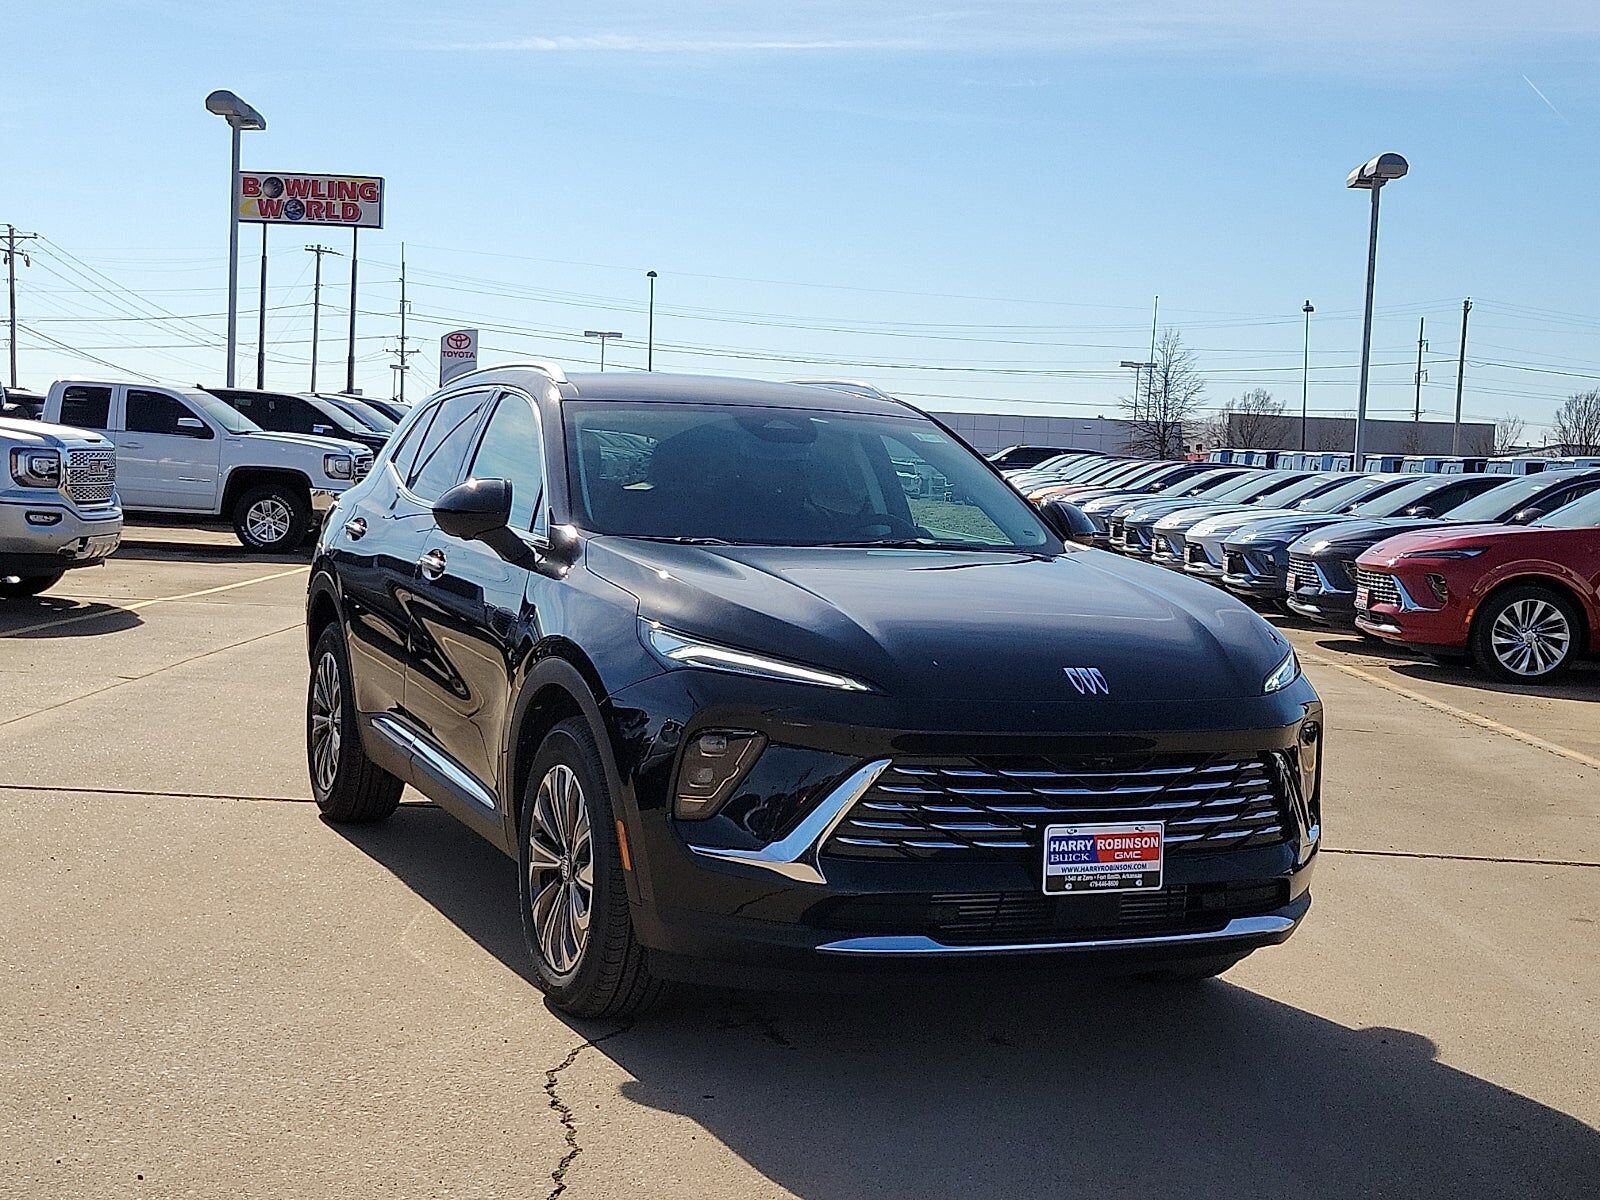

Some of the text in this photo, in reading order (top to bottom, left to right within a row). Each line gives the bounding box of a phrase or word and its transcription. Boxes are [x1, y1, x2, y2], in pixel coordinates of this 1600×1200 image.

[242, 176, 379, 202] BOWLING
[257, 199, 362, 222] WORLD
[1050, 837, 1159, 852] HARRY ROBINSON
[1050, 851, 1142, 862] BUICK GMC
[1061, 863, 1147, 873] WWW.HARRYROBINSON.COM
